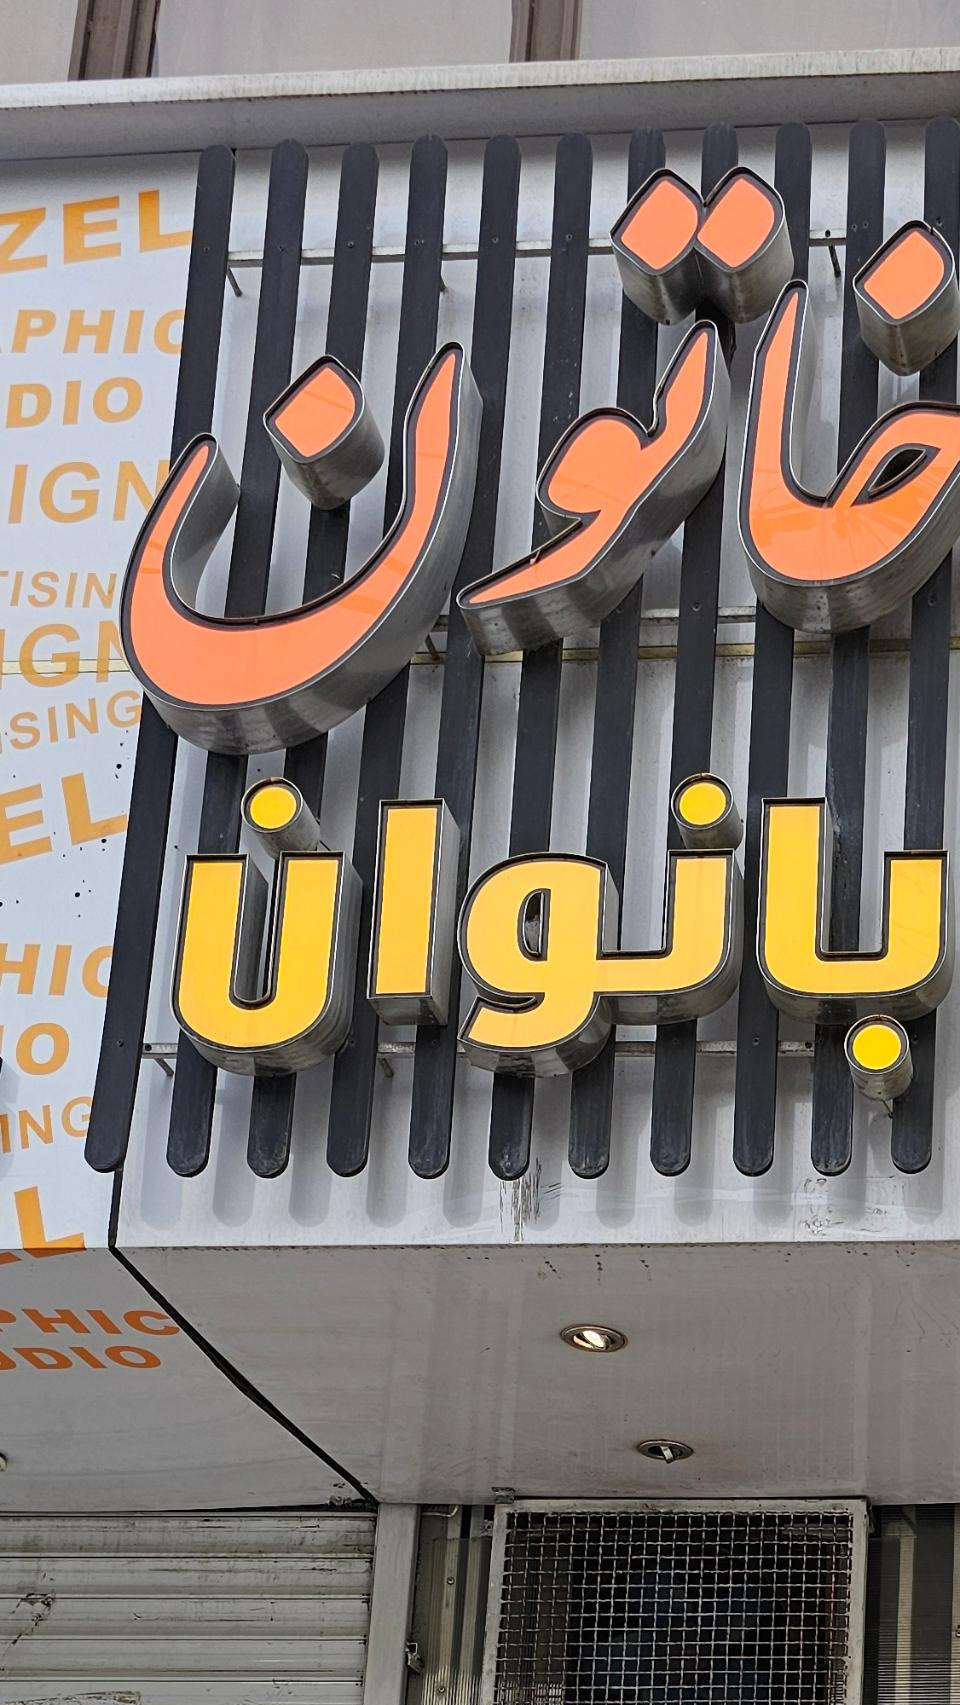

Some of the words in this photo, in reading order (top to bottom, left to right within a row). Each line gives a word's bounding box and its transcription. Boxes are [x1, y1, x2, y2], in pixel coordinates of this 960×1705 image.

[0, 189, 191, 274] ZEL
[6, 376, 143, 429] DIO
[0, 570, 117, 609] ISIN
[170, 773, 950, 1078] بانوان
